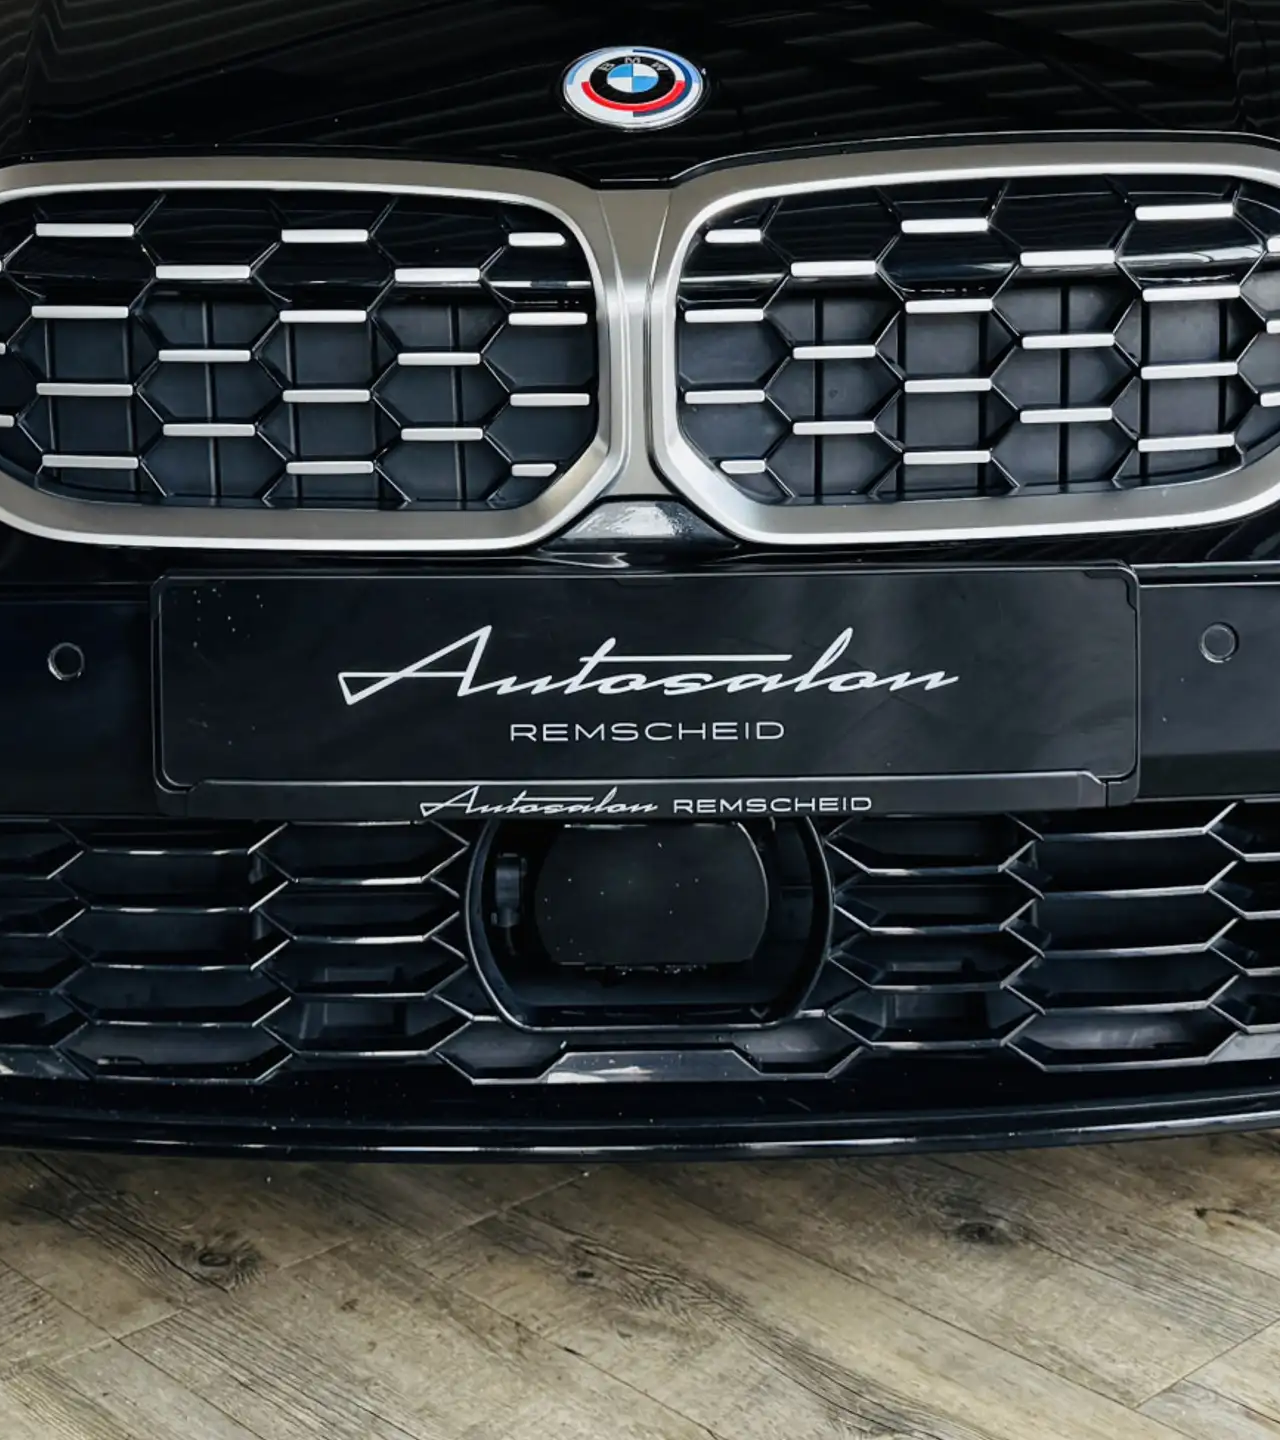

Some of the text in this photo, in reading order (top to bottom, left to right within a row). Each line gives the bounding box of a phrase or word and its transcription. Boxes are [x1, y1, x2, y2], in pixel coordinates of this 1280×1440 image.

[337, 624, 960, 706] Autosalon
[510, 721, 786, 742] REMSCHEID
[419, 785, 872, 817] Autosalon REMSCHEID
